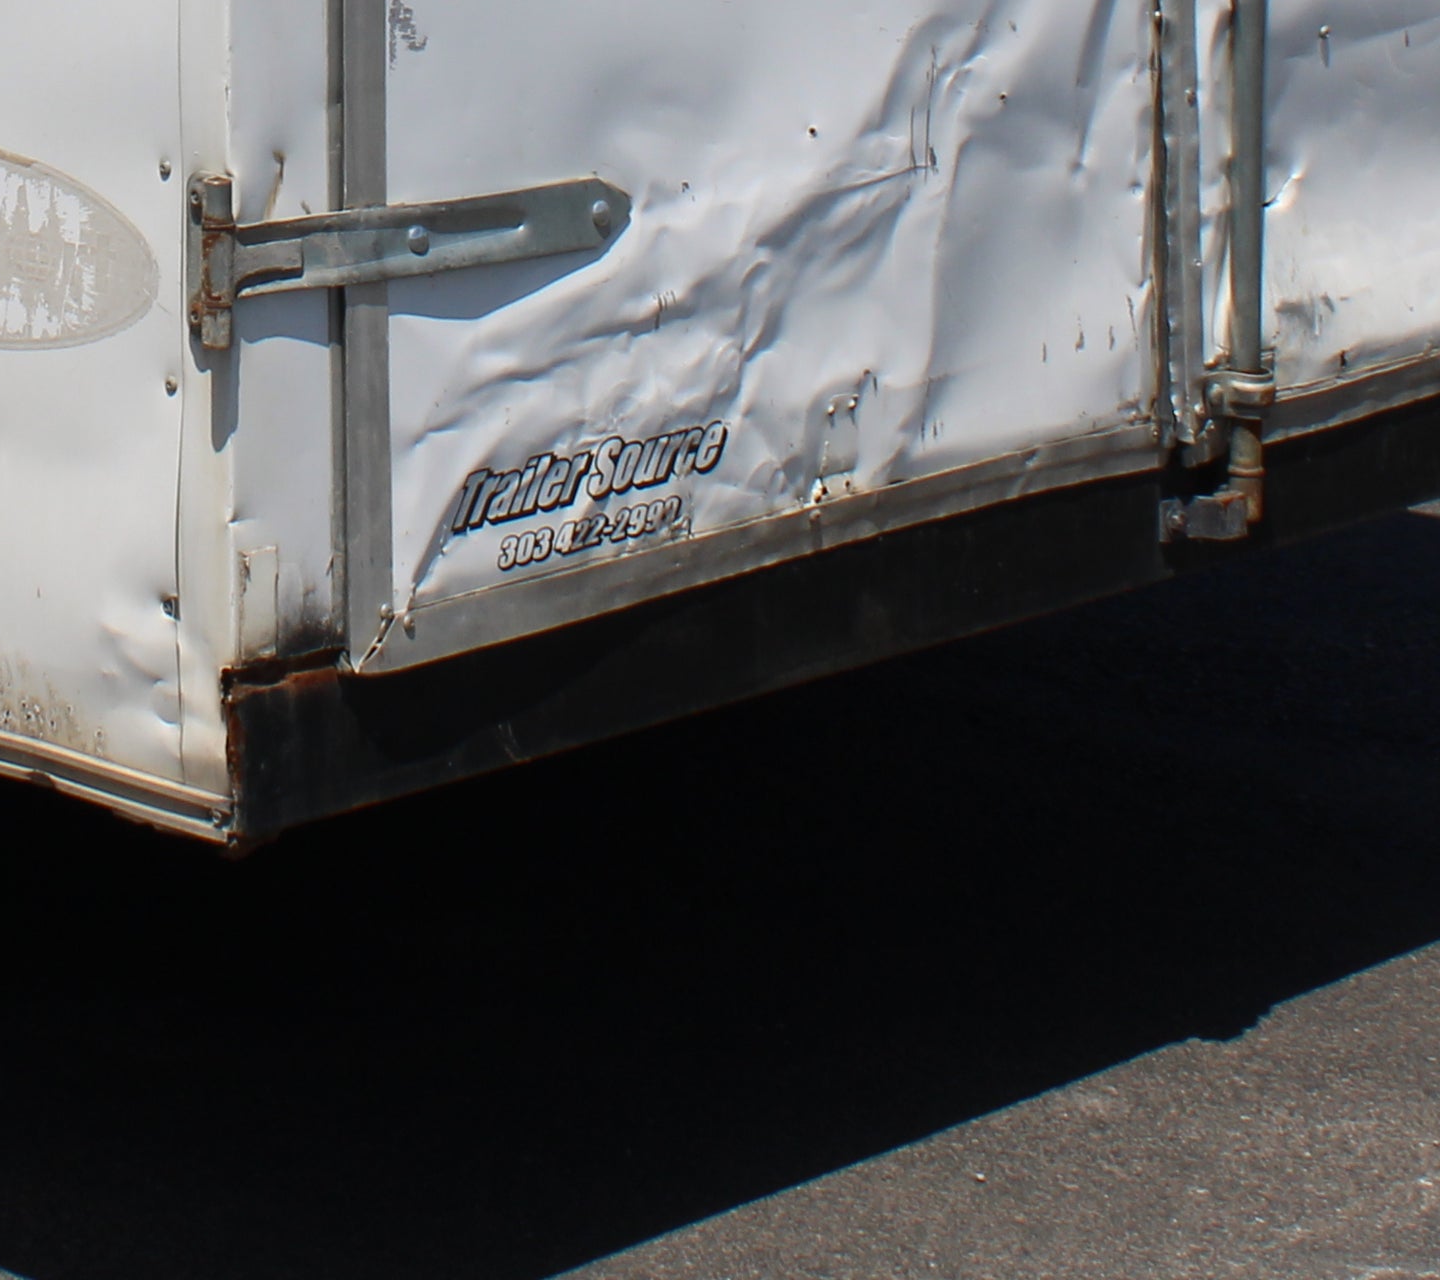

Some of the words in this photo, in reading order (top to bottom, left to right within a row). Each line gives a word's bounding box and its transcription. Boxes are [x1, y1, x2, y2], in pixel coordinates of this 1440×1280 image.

[451, 451, 595, 535] Trailer
[587, 419, 729, 501] Source
[497, 525, 554, 571] 303
